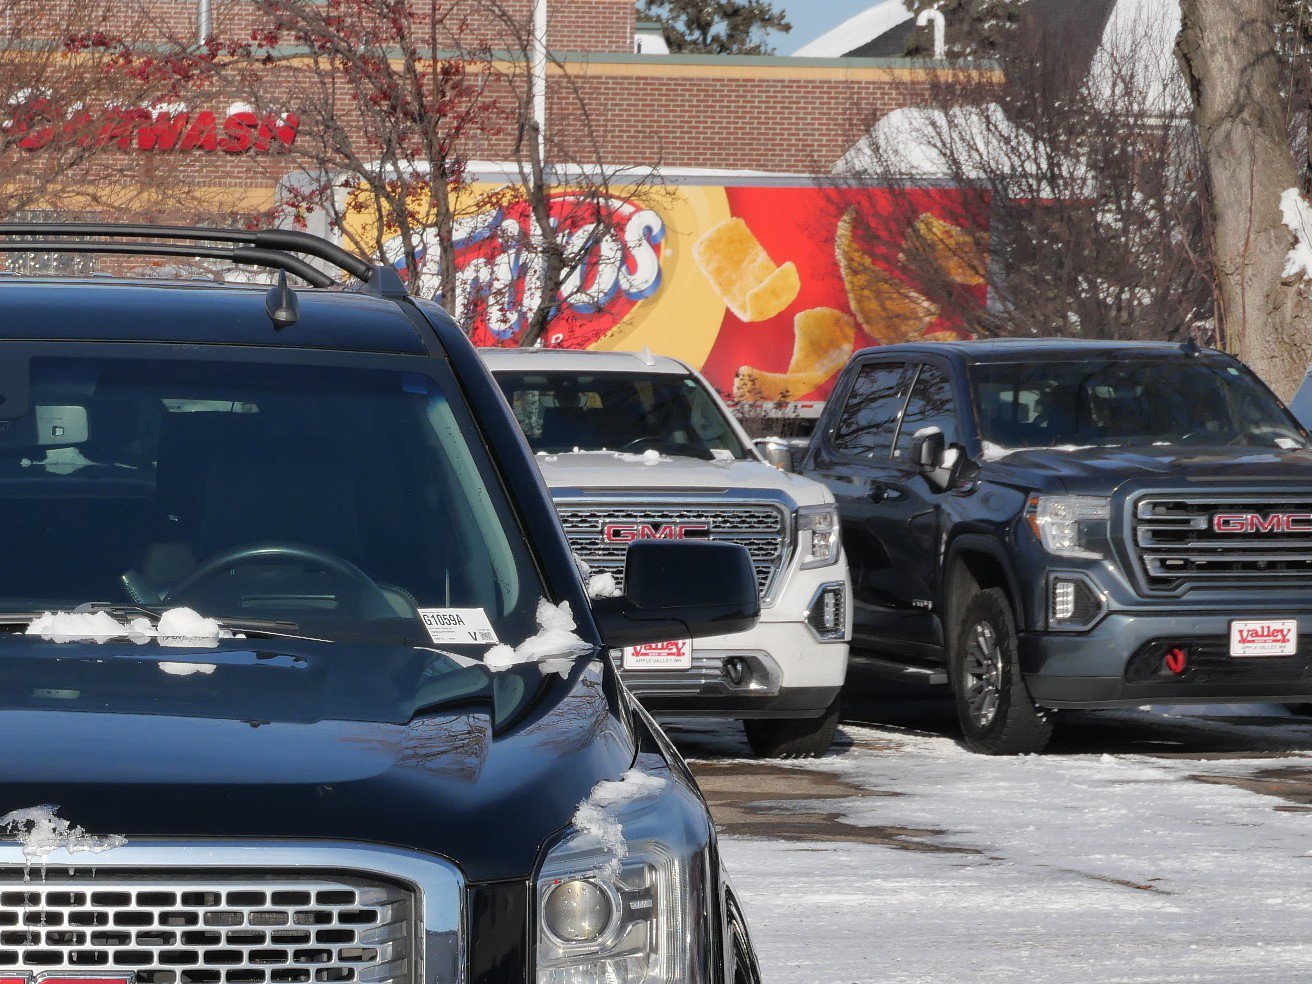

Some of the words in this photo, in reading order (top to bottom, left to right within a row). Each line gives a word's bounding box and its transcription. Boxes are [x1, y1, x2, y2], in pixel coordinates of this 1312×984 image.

[1214, 514, 1312, 532] GMC
[605, 524, 709, 543] GMC
[423, 614, 465, 625] G1059A
[1238, 626, 1291, 644] Valley
